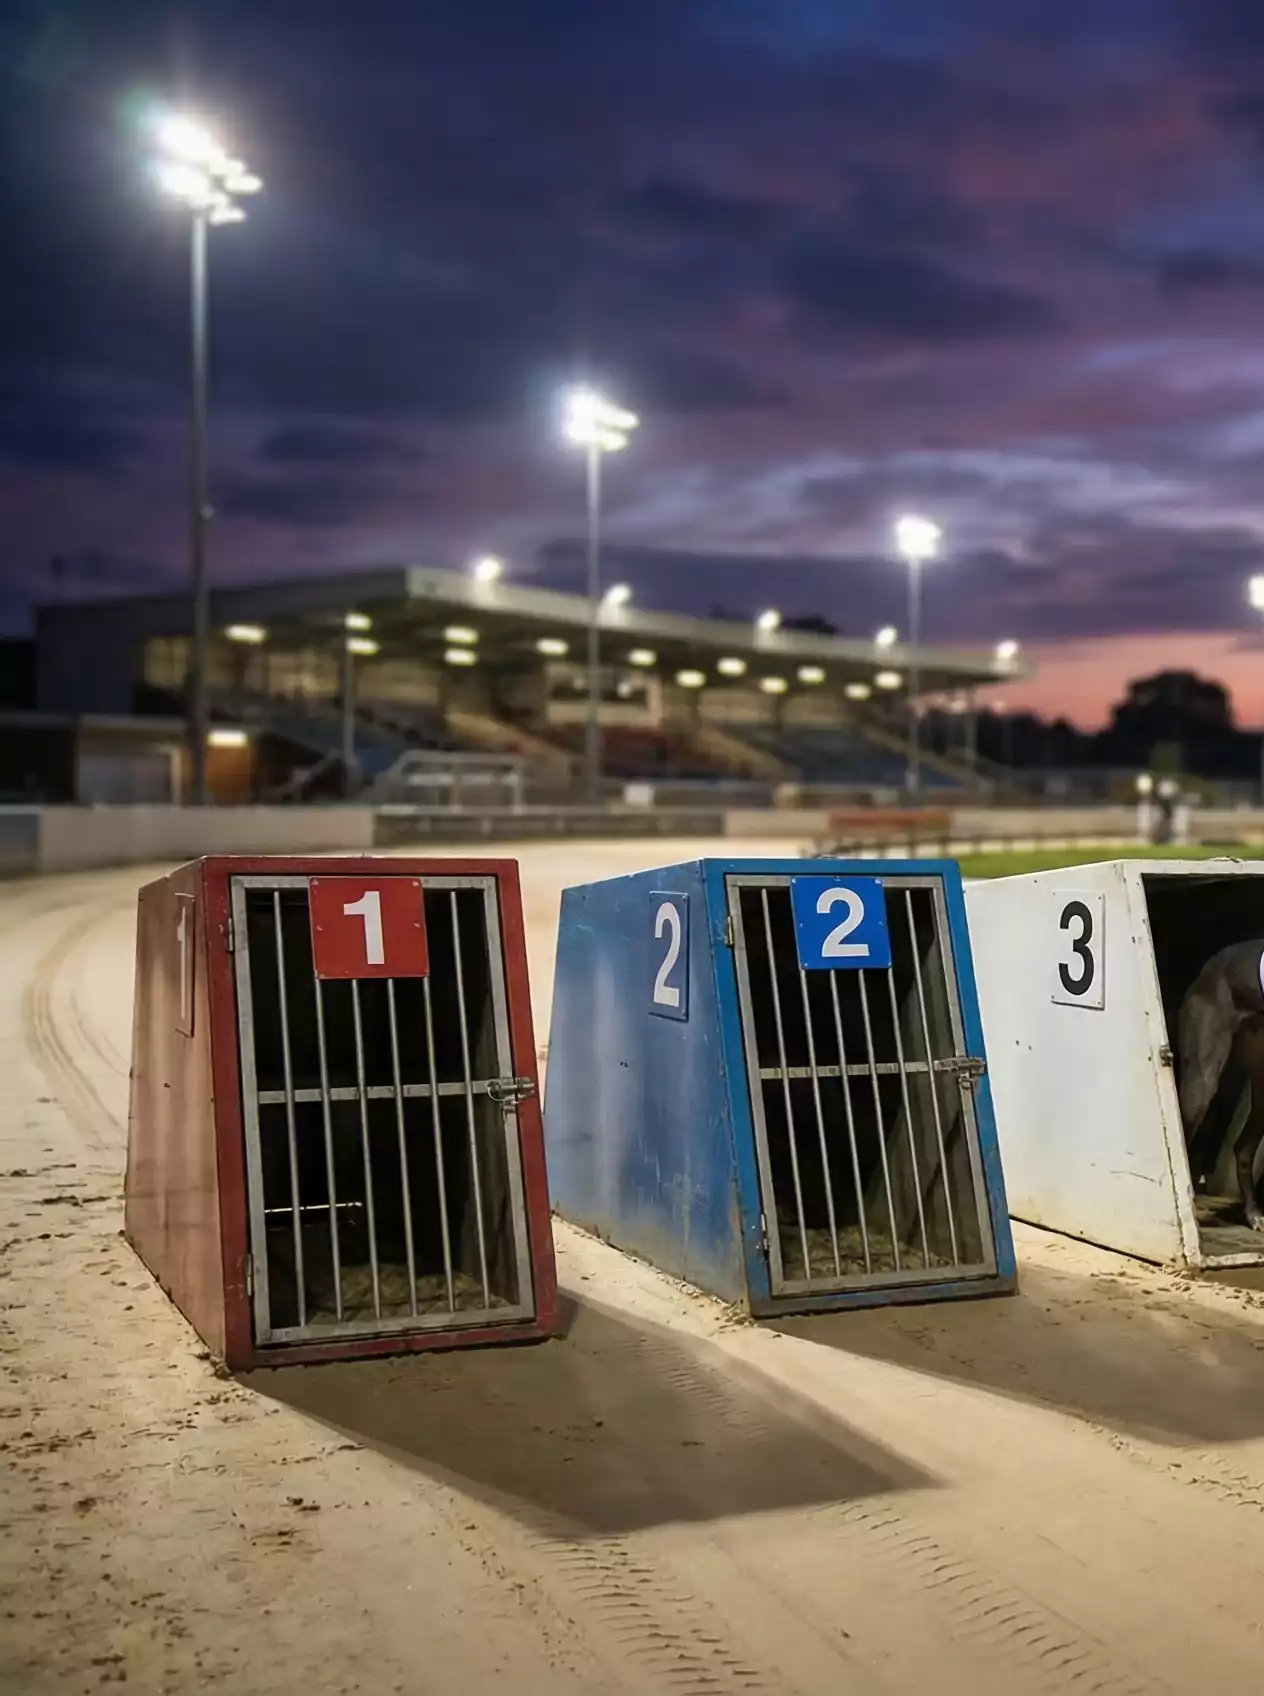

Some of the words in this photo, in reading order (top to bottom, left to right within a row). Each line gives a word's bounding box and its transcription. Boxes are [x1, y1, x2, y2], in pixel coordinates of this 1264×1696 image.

[177, 906, 186, 1019] 1
[344, 891, 385, 964] 1
[654, 902, 681, 1007] 2
[816, 888, 870, 957] 2
[1059, 901, 1094, 995] 3
